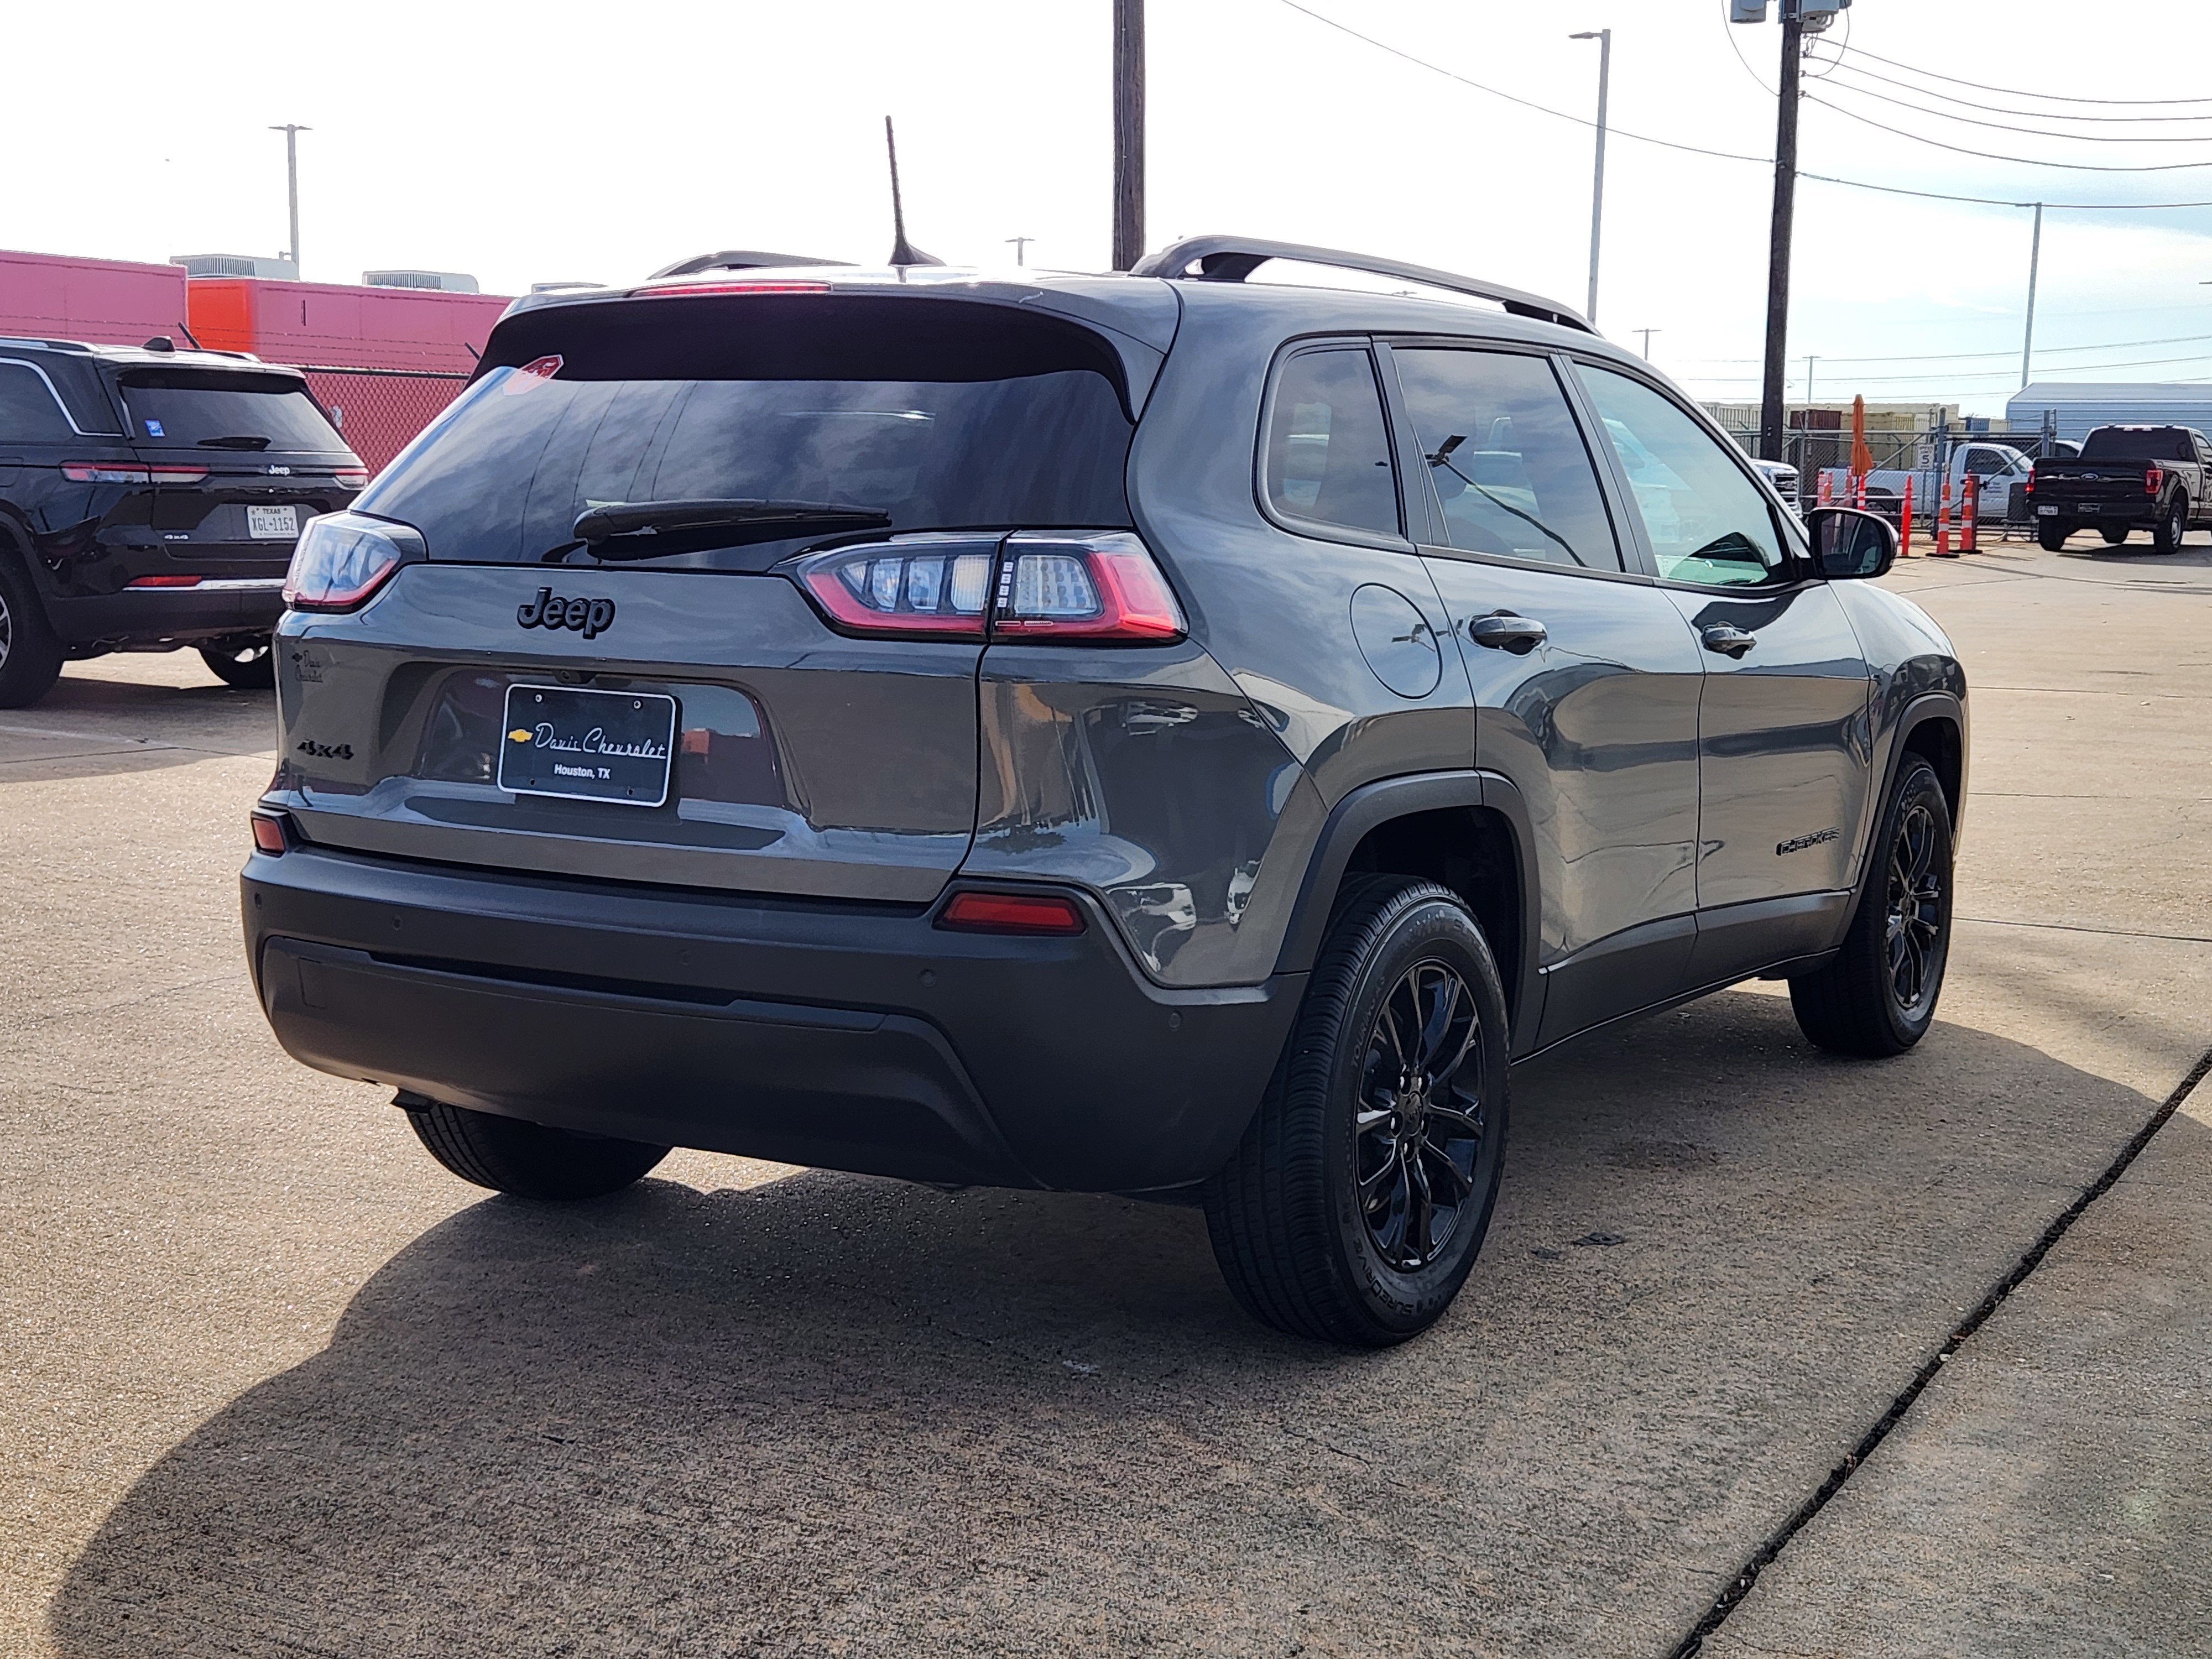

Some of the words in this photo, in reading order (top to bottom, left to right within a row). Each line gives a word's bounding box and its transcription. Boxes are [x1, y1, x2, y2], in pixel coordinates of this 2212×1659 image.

[1921, 455, 1929, 464] 5
[268, 465, 290, 476] Jeep
[517, 587, 615, 640] Jeep
[535, 722, 581, 752] Davis
[583, 727, 666, 759] Chevrolet
[555, 764, 594, 779] Houston,
[598, 768, 611, 779] TX
